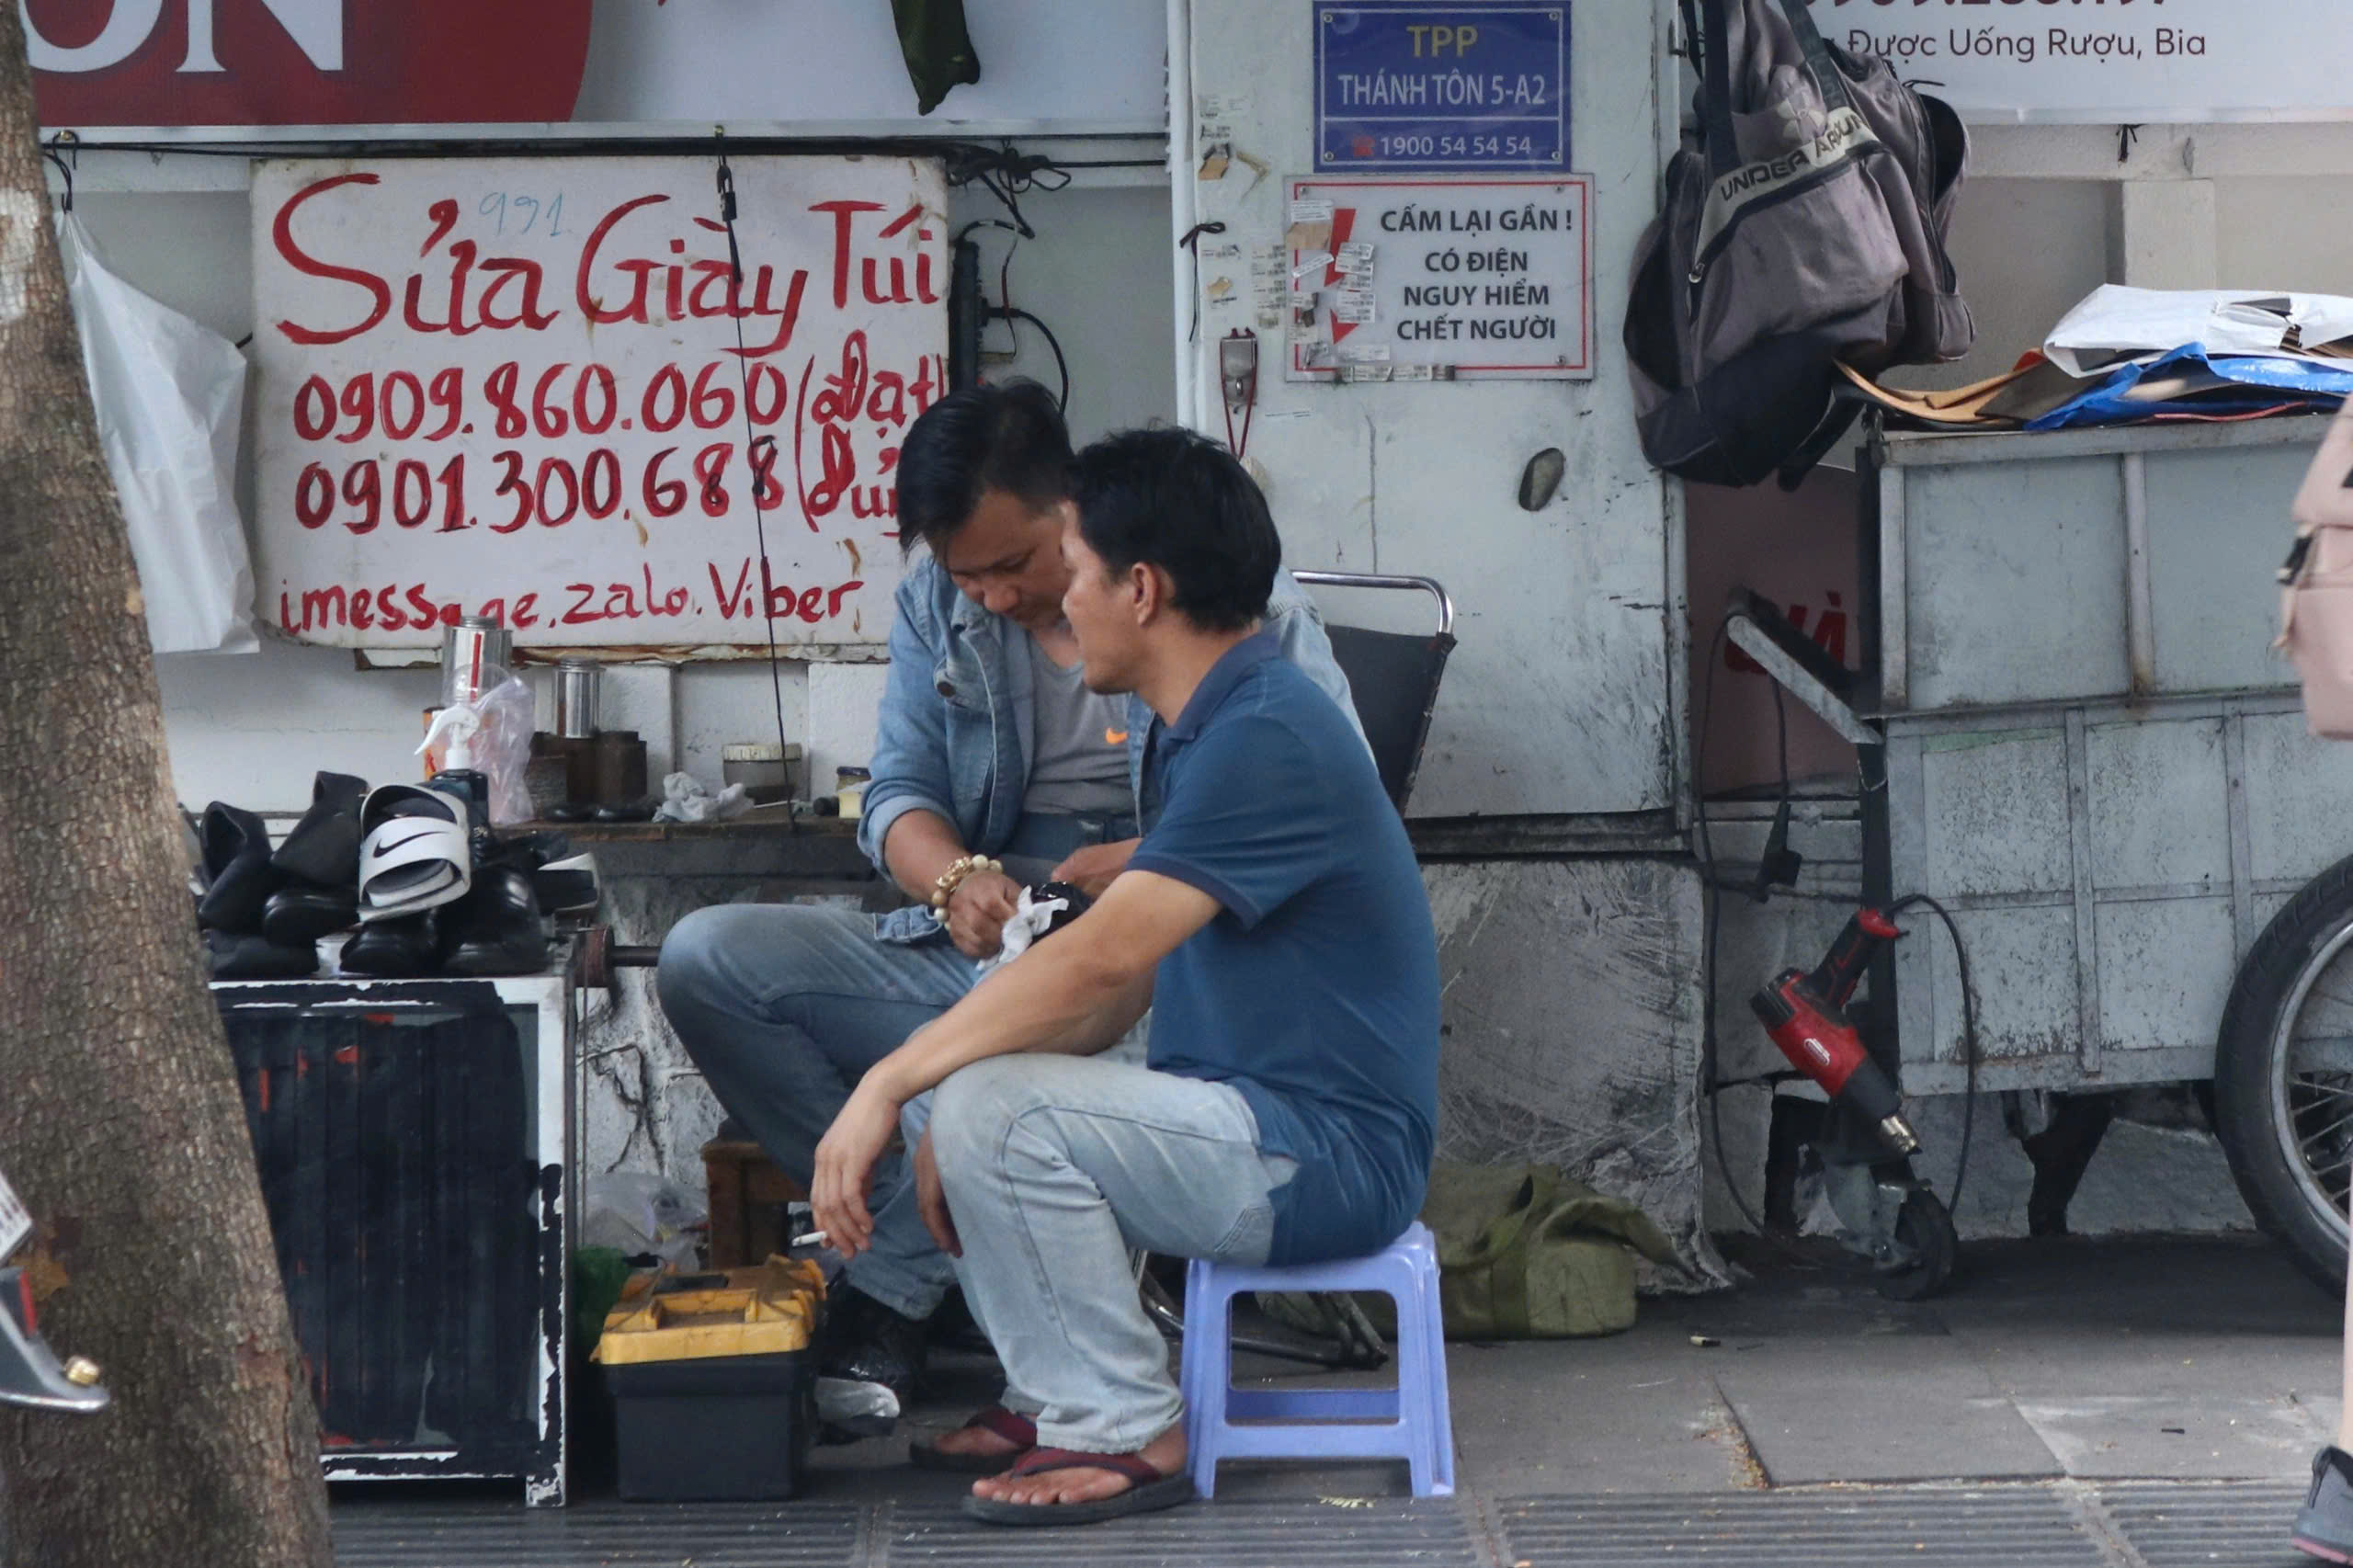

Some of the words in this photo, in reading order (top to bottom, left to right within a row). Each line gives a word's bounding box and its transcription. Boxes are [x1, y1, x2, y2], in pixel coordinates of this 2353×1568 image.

[1405, 25, 1479, 58] TPP
[1847, 29, 1937, 64] Được
[1949, 26, 2035, 63] Uống
[2048, 28, 2142, 63] Rượu,
[2155, 28, 2205, 55] Bia
[1337, 67, 1427, 106] THÁNH
[1431, 67, 1483, 106] TÔN
[1490, 74, 1546, 105] 5-A2
[1381, 136, 1434, 156] 1900
[1440, 136, 1467, 155] 54
[1473, 136, 1500, 155] 54
[1505, 136, 1532, 155] 54
[1381, 203, 1442, 232] CẤM
[1450, 210, 1491, 238] LẠI
[1499, 203, 1558, 231] GẦN
[273, 173, 559, 346] Sửa
[576, 194, 808, 358] Giày
[808, 199, 939, 309] Túi
[1425, 247, 1460, 272] CÓ
[1466, 247, 1528, 278] ĐIỆN
[1404, 285, 1477, 306] NGUY
[1484, 278, 1550, 306] HIỂM
[1397, 312, 1463, 341] CHẾT
[1470, 314, 1555, 340] NGƯỜI
